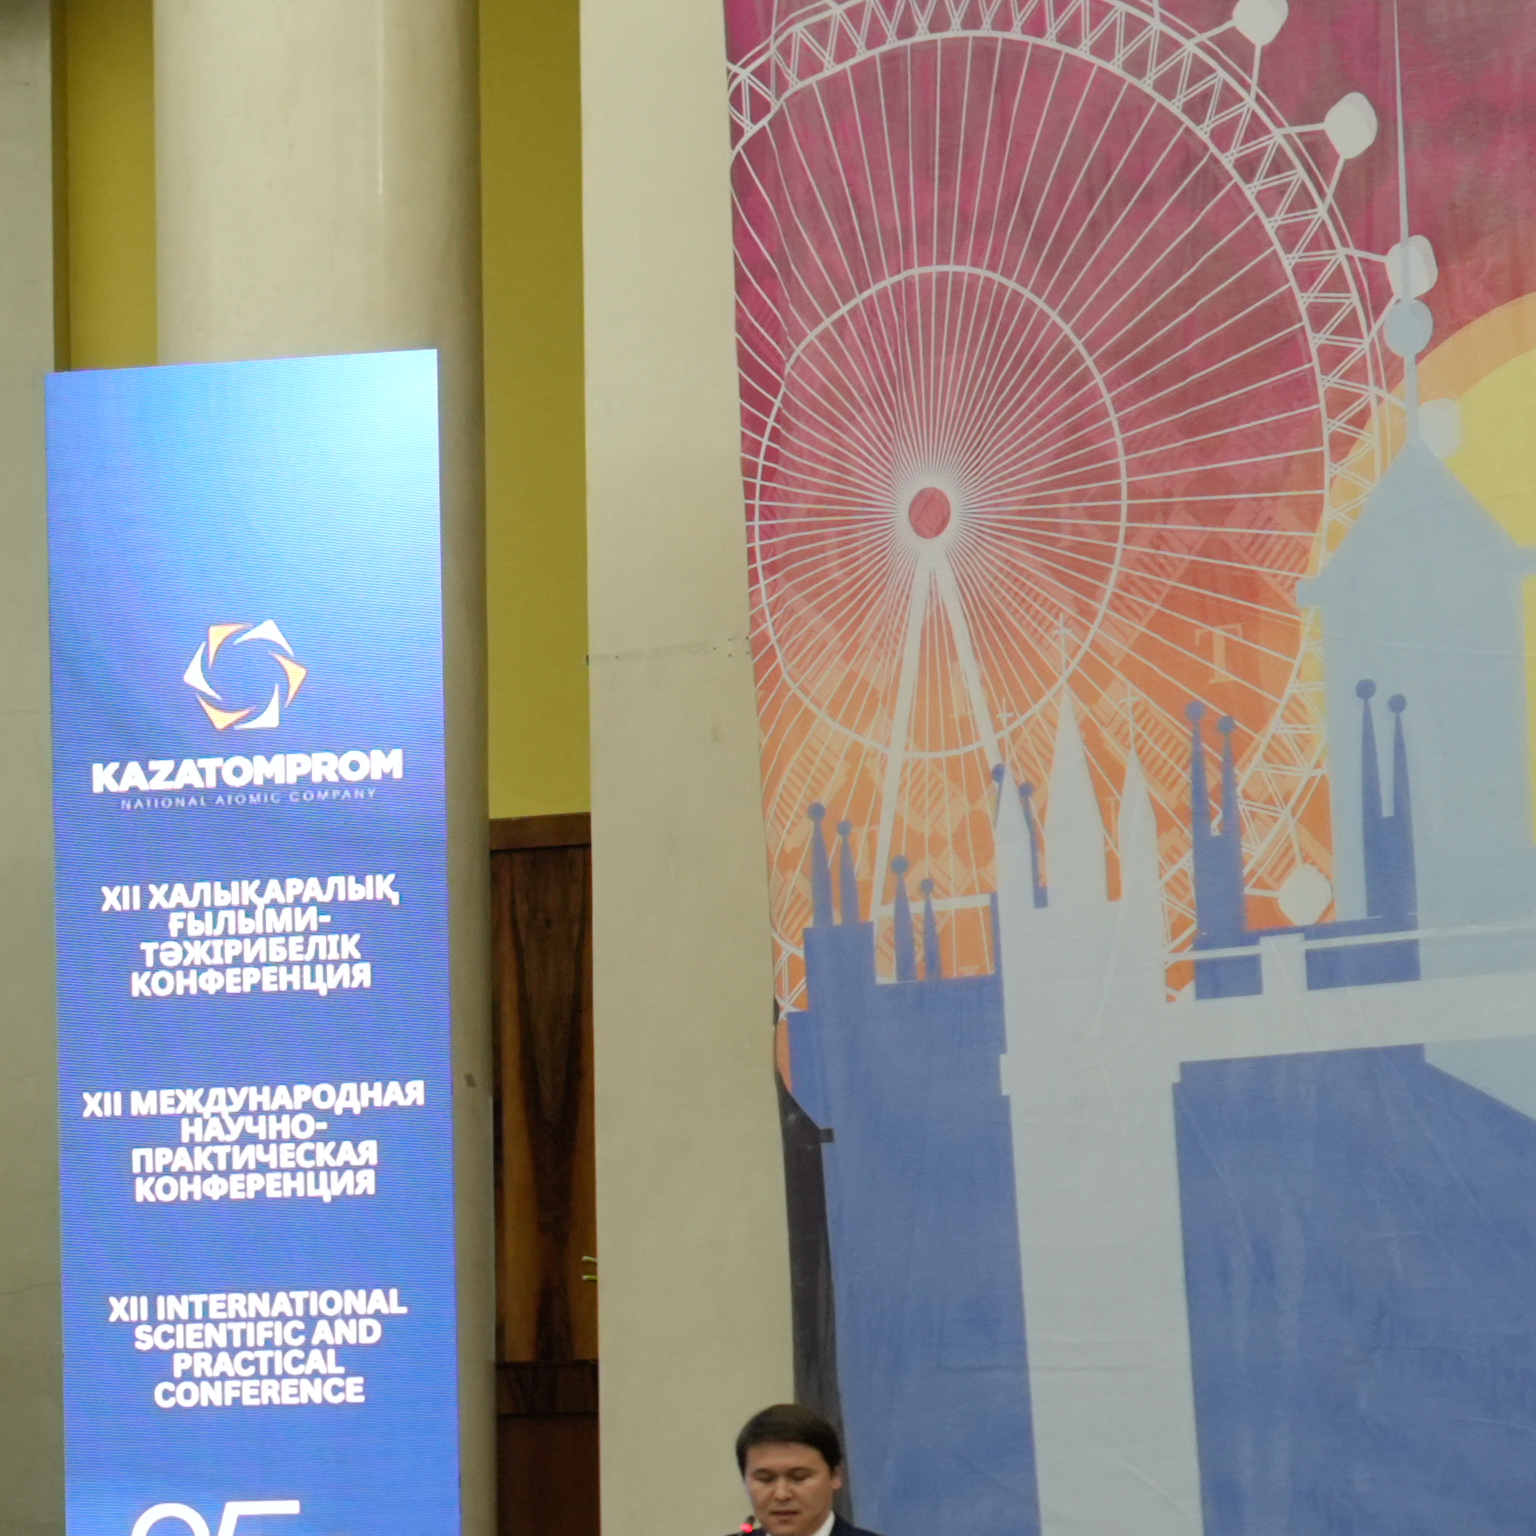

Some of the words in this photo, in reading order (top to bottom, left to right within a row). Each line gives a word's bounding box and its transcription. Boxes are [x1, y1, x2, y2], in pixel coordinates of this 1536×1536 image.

[92, 749, 403, 793] KAZATOMPROM
[121, 795, 208, 810] NATIONAL
[215, 791, 279, 806] ATOMIC
[290, 788, 377, 803] COMPANY
[149, 873, 400, 912] ХАЛЫҚАРАЛЫҚ
[140, 934, 361, 967] ТӘЖІРИБЕЛІК
[131, 963, 371, 997] КОНФЕРЕНЦИЯ
[131, 1080, 424, 1118] МЕЖДУНАРОДНАЯ
[181, 1114, 327, 1142] НАУЧНО-
[132, 1140, 377, 1174] ПРАКТИЧЕСКАЯ
[135, 1169, 375, 1203] КОНФЕРЕНЦИЯ
[109, 1296, 148, 1322] XII
[157, 1289, 407, 1320] INTERNATIONAL
[135, 1320, 305, 1350] SCIENTIFIC
[312, 1319, 381, 1345] AND
[173, 1349, 345, 1378] PRACTICAL
[154, 1377, 365, 1408] CONFERENCE
